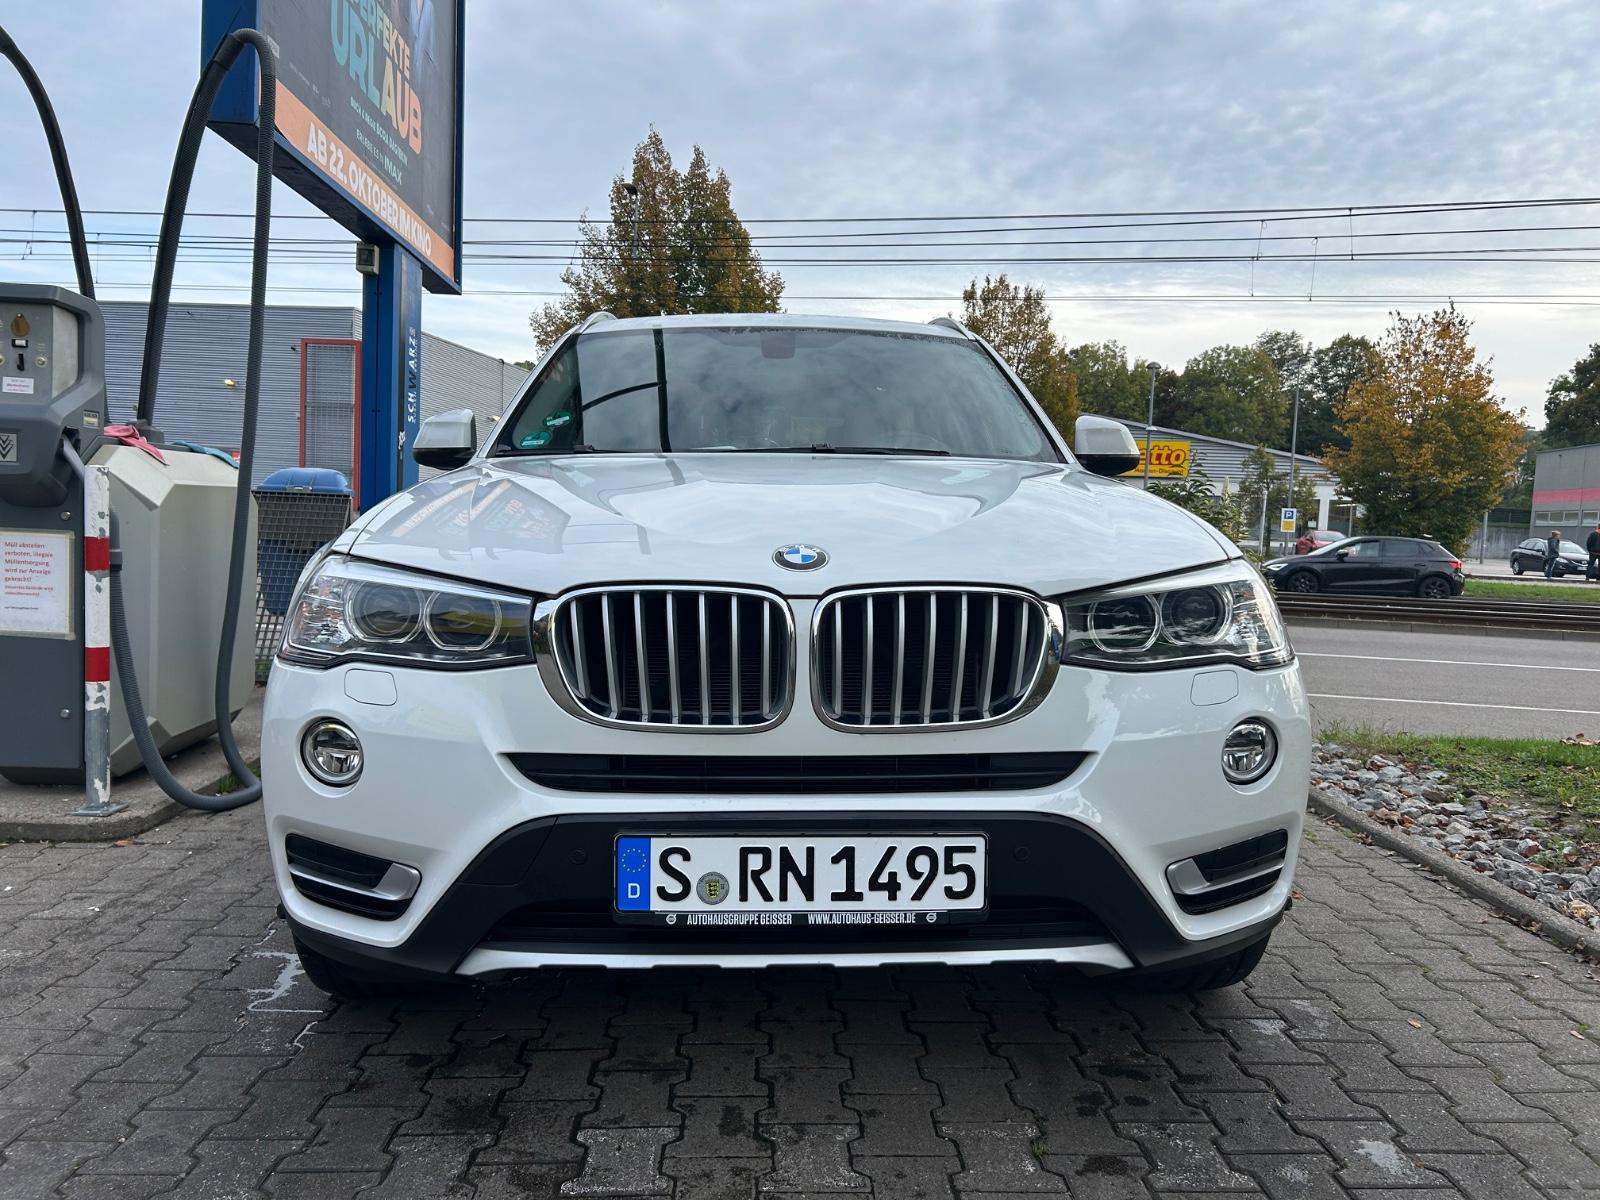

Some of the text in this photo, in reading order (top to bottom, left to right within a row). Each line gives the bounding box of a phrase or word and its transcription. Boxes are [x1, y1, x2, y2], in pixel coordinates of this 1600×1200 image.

[331, 0, 421, 154] URLAUB
[307, 121, 328, 167] AB
[329, 142, 349, 185] 22.
[348, 160, 399, 230] OKTOBER
[399, 206, 412, 240] IM
[411, 219, 432, 257] KINO
[384, 154, 402, 185] IMAX
[628, 883, 640, 899] D
[656, 846, 692, 902] S
[739, 846, 816, 902] RN
[830, 846, 977, 902] 1495
[687, 913, 759, 925] AUTOHAUSGRUPPE
[760, 913, 793, 925] GEISSER
[807, 912, 916, 925] WWW.AUTOHAUS-GEISSER.DE
